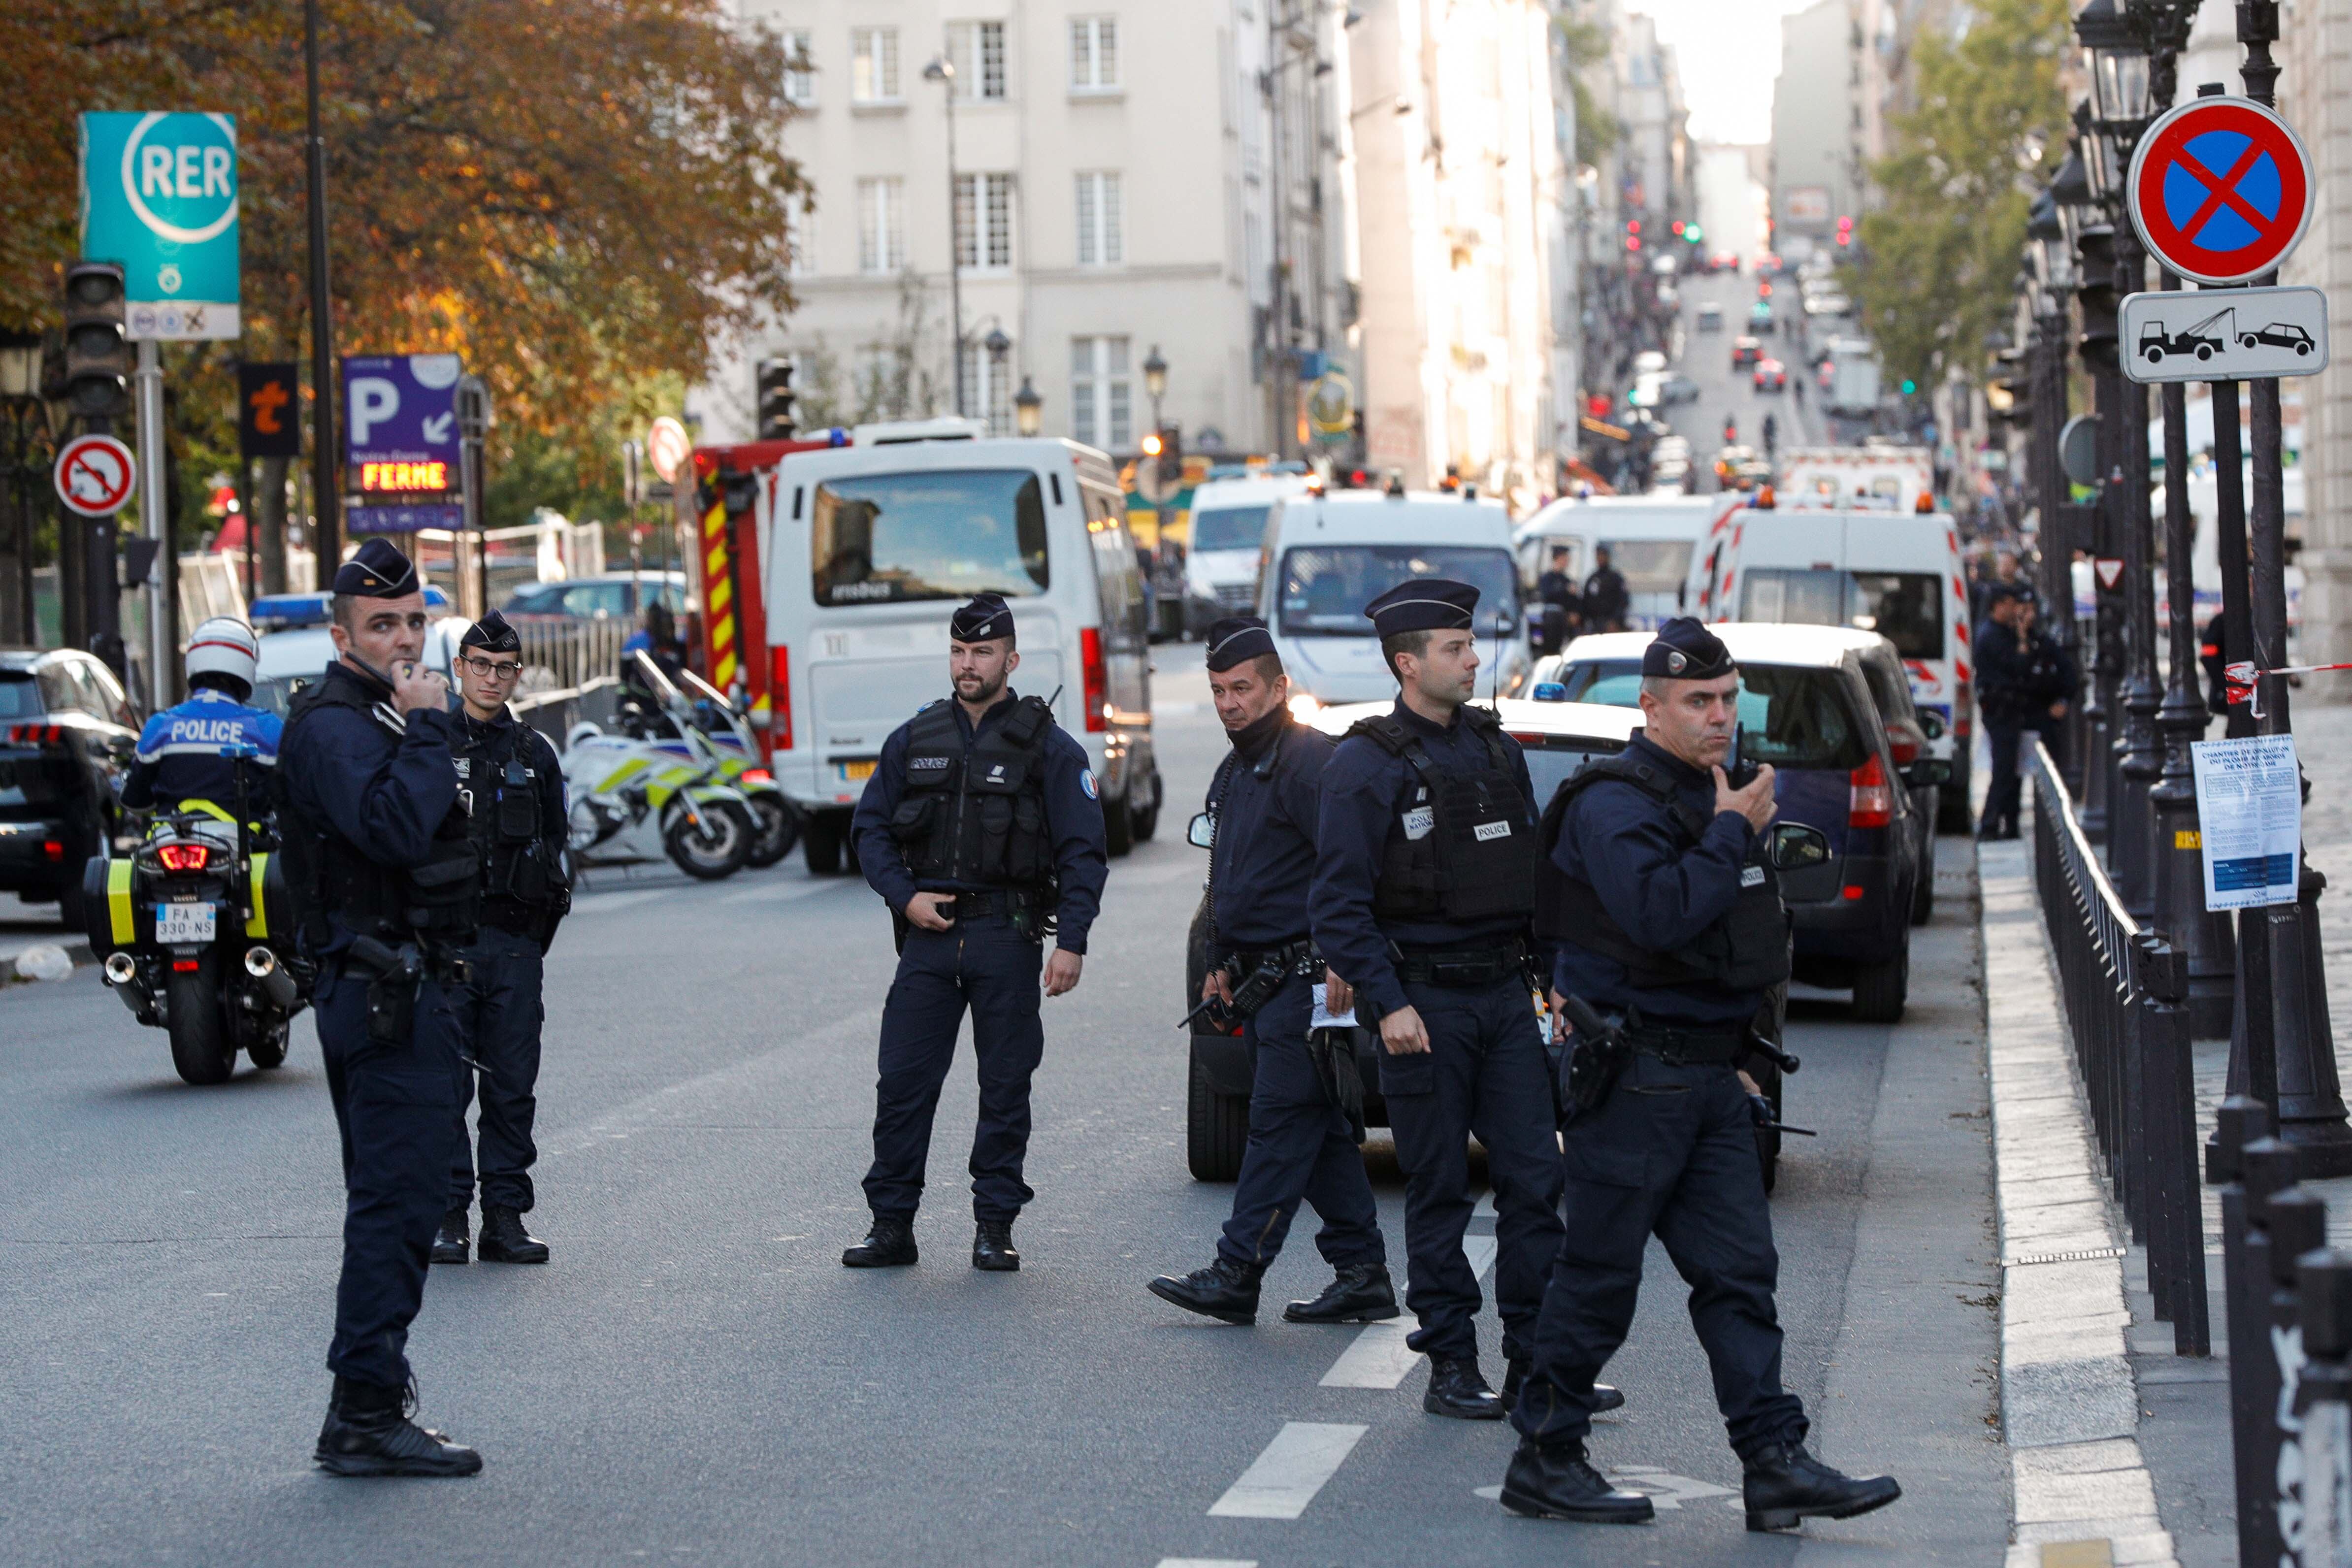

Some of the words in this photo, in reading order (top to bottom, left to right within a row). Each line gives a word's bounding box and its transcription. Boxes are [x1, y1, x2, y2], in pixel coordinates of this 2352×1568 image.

[141, 144, 231, 197] RER
[349, 377, 400, 446] P
[362, 461, 448, 490] FERME
[171, 719, 244, 743] POLICE
[1478, 824, 1508, 838] POLICE
